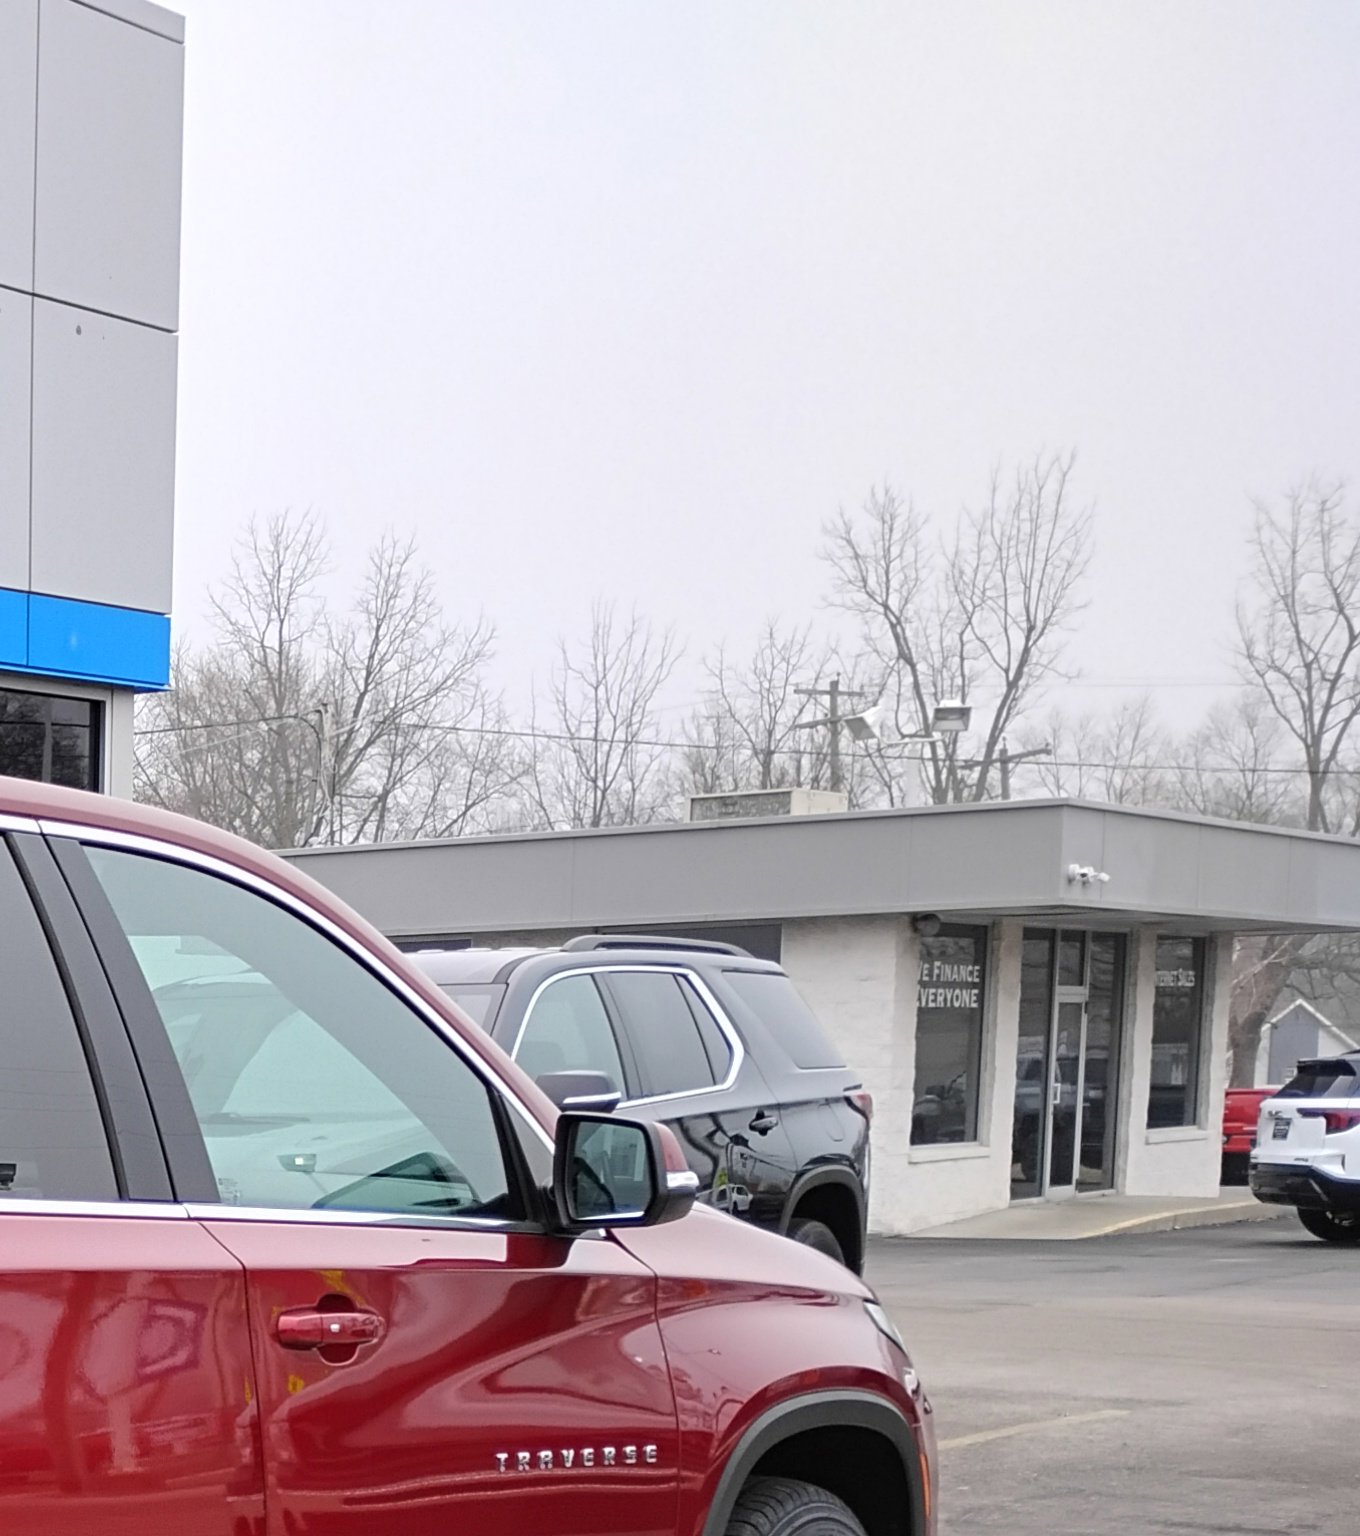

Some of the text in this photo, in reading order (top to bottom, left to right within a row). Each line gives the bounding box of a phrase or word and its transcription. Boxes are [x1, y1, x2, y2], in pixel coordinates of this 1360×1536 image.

[933, 960, 980, 982] FINANCE
[918, 988, 979, 1008] VERYONE
[494, 1444, 658, 1473] TRAVERSE
